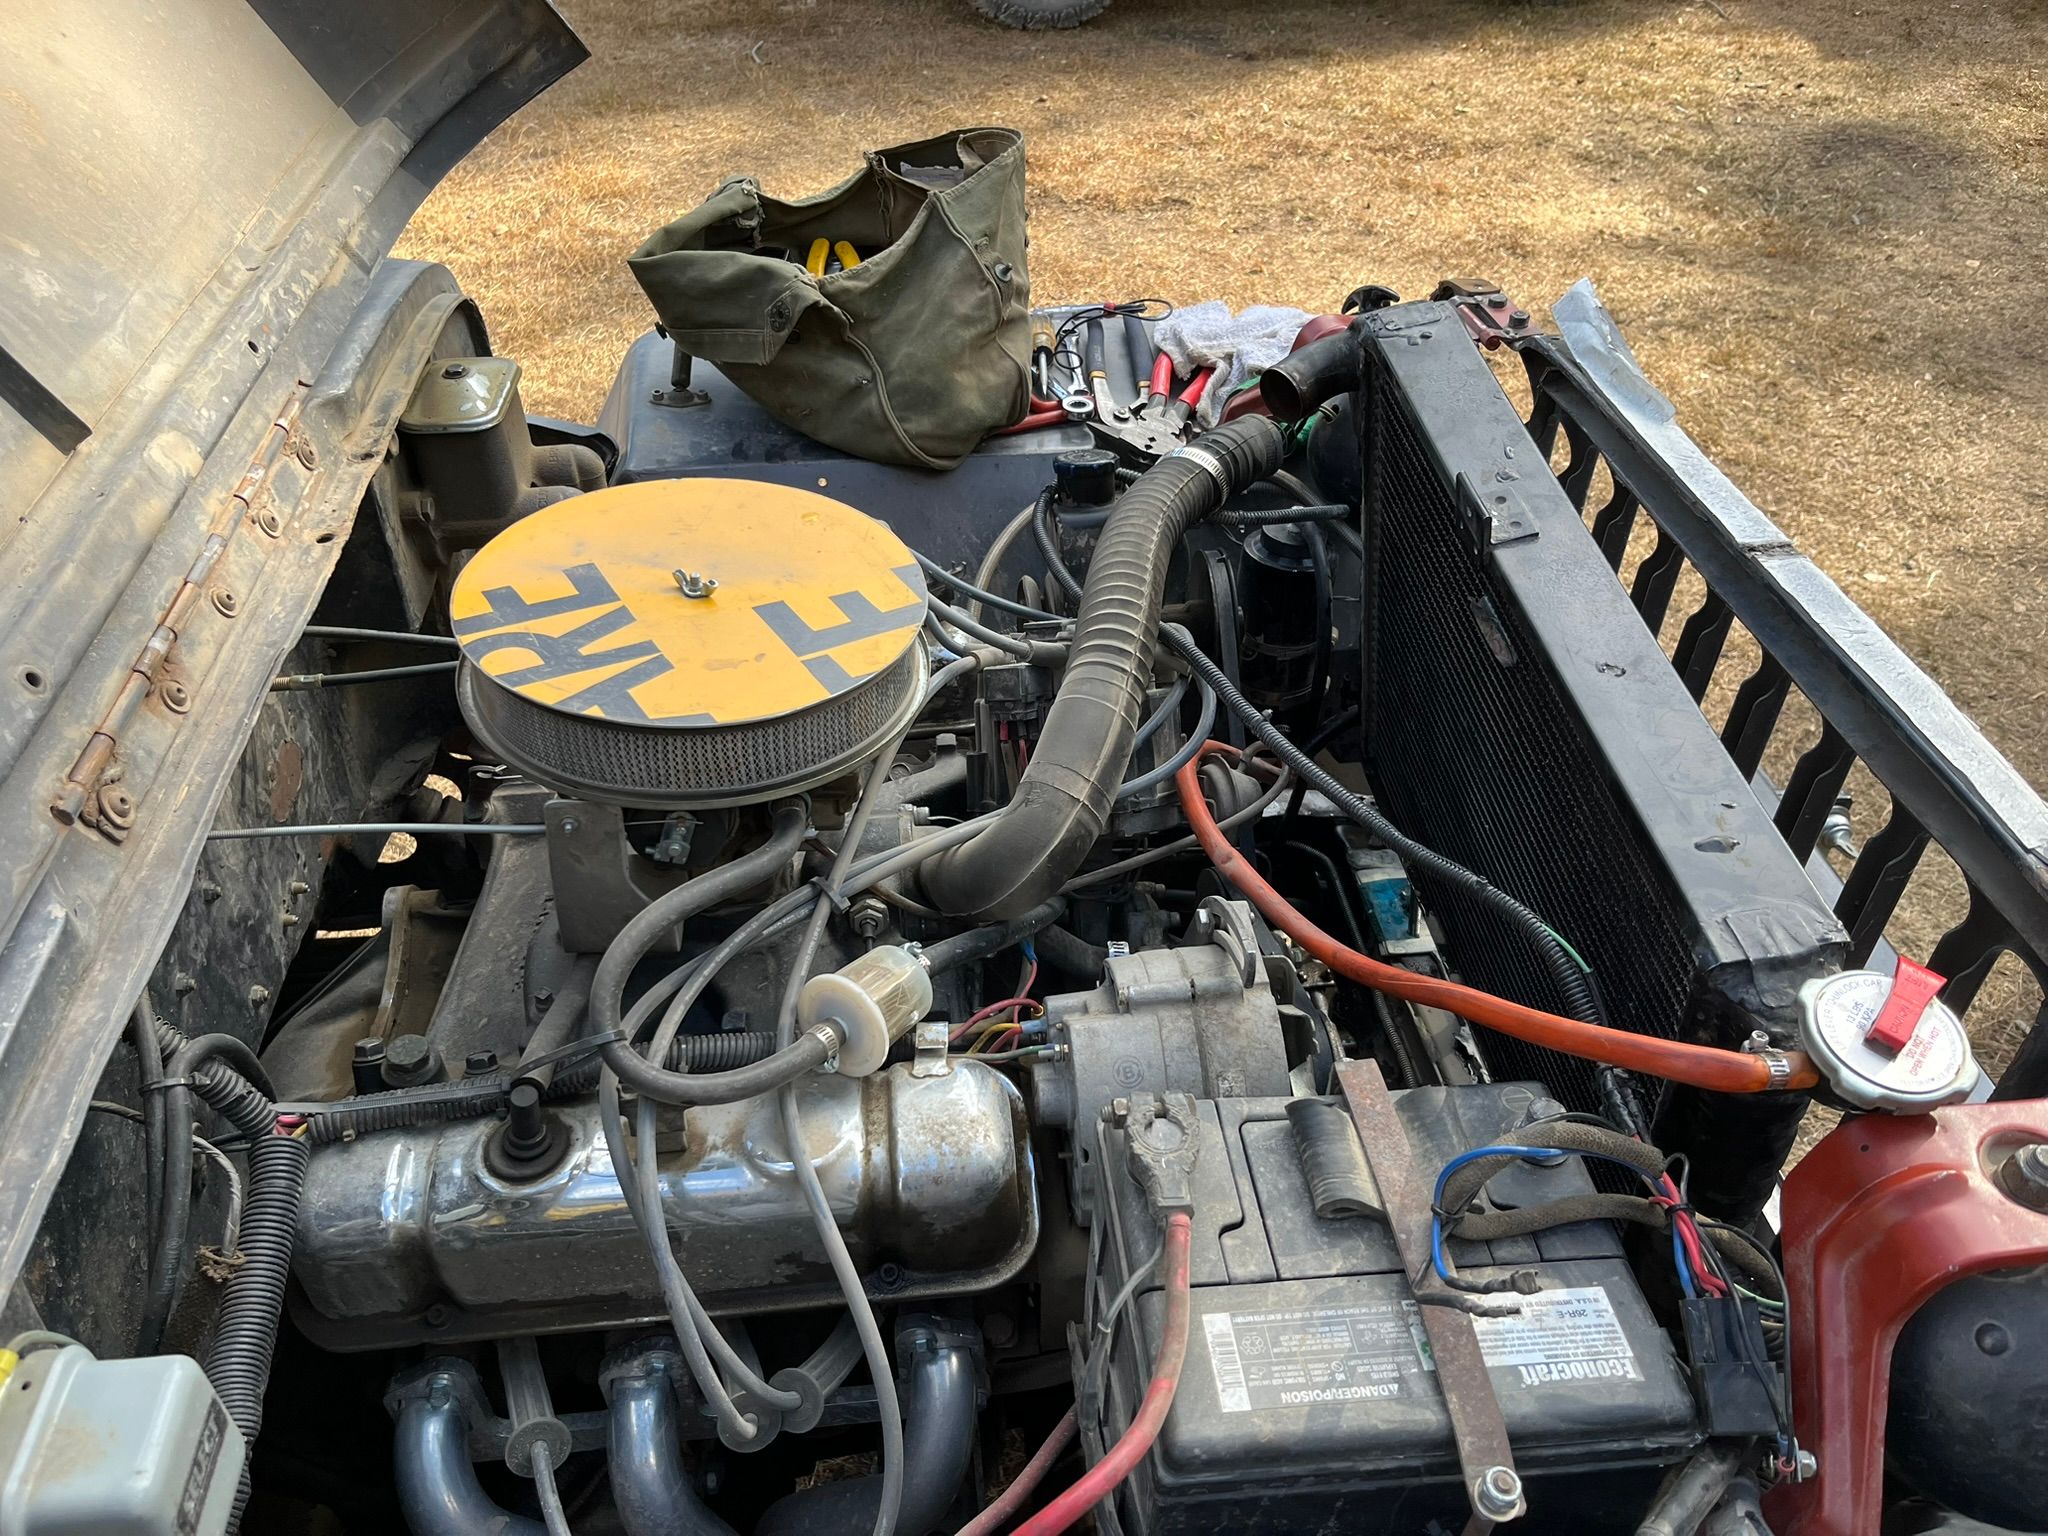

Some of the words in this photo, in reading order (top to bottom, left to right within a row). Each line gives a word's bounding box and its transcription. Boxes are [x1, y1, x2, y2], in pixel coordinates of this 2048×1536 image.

[1846, 1013, 1856, 1024] 13
[1912, 1035, 1925, 1049] NOT
[1909, 1056, 1923, 1077] OPEN
[1918, 1039, 1933, 1062] WHEN
[1928, 1027, 1942, 1043] HOT
[1556, 1307, 1589, 1319] 26R-E
[1517, 1357, 1638, 1387] Econocraft
[1281, 1384, 1390, 1404] DANGER/POISON
